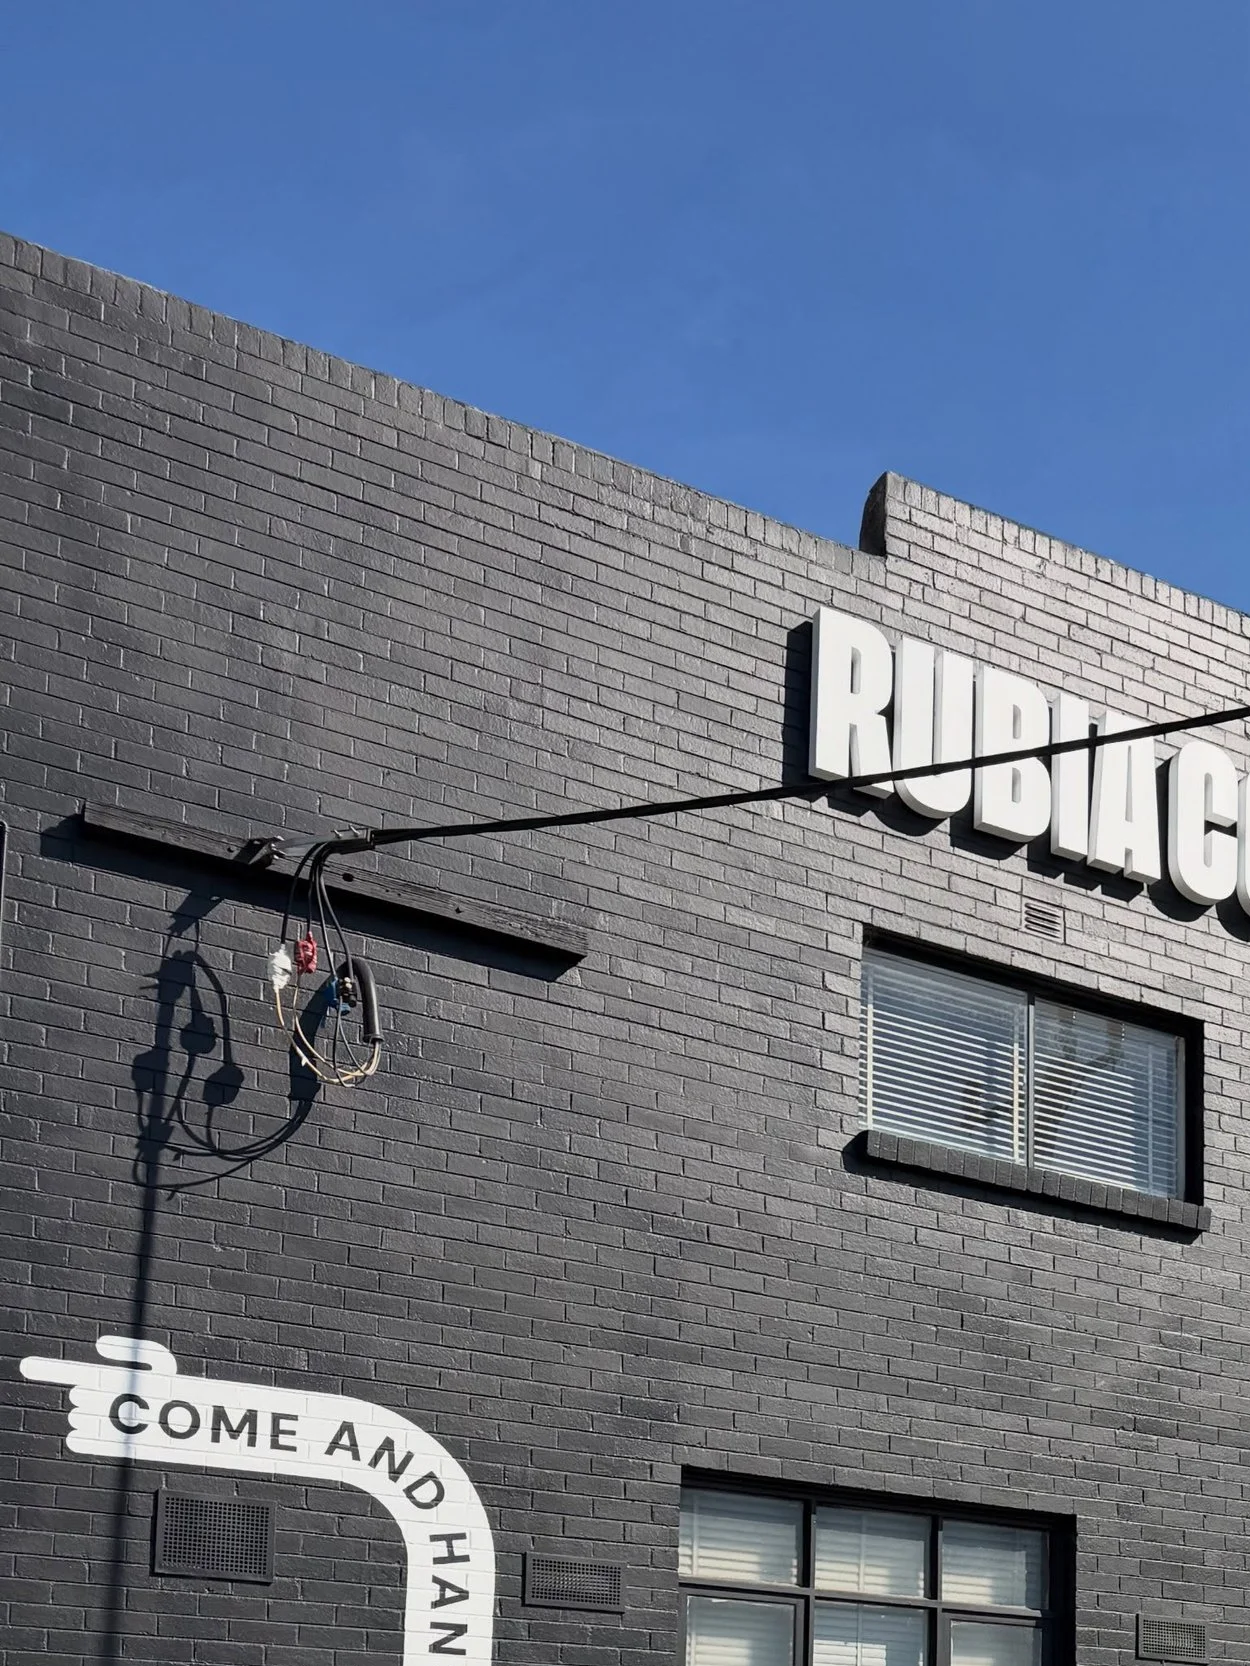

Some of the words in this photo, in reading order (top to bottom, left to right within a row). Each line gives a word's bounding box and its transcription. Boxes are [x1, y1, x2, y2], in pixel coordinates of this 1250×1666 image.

[809, 606, 1161, 886] RUBIA
[108, 1393, 298, 1453] COME
[325, 1420, 446, 1512] AND
